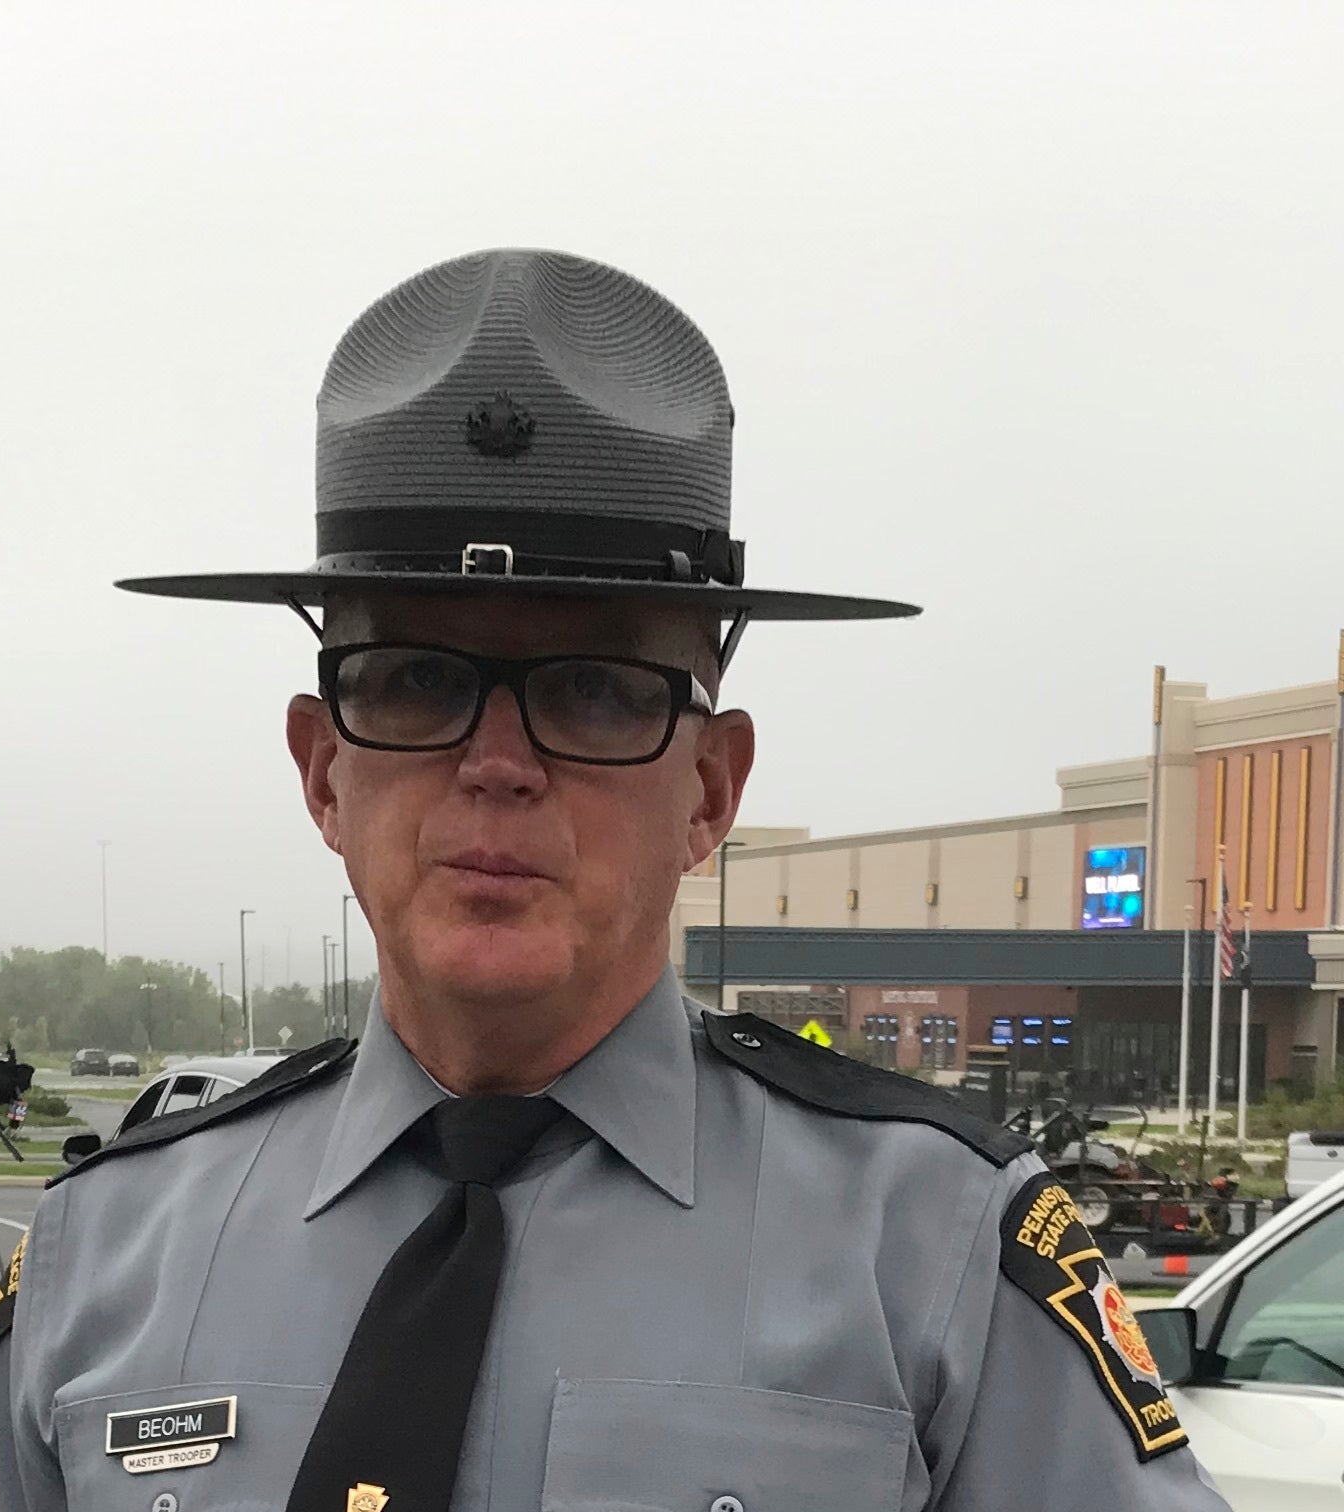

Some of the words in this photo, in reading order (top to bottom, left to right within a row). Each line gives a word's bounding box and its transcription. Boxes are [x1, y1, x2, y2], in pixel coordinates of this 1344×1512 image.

[1016, 1185, 1076, 1248] PENNSY
[1036, 1207, 1071, 1260] STATE
[138, 1413, 203, 1440] BEOHM
[127, 1455, 164, 1470] MASTER
[168, 1448, 212, 1464] TROOPER
